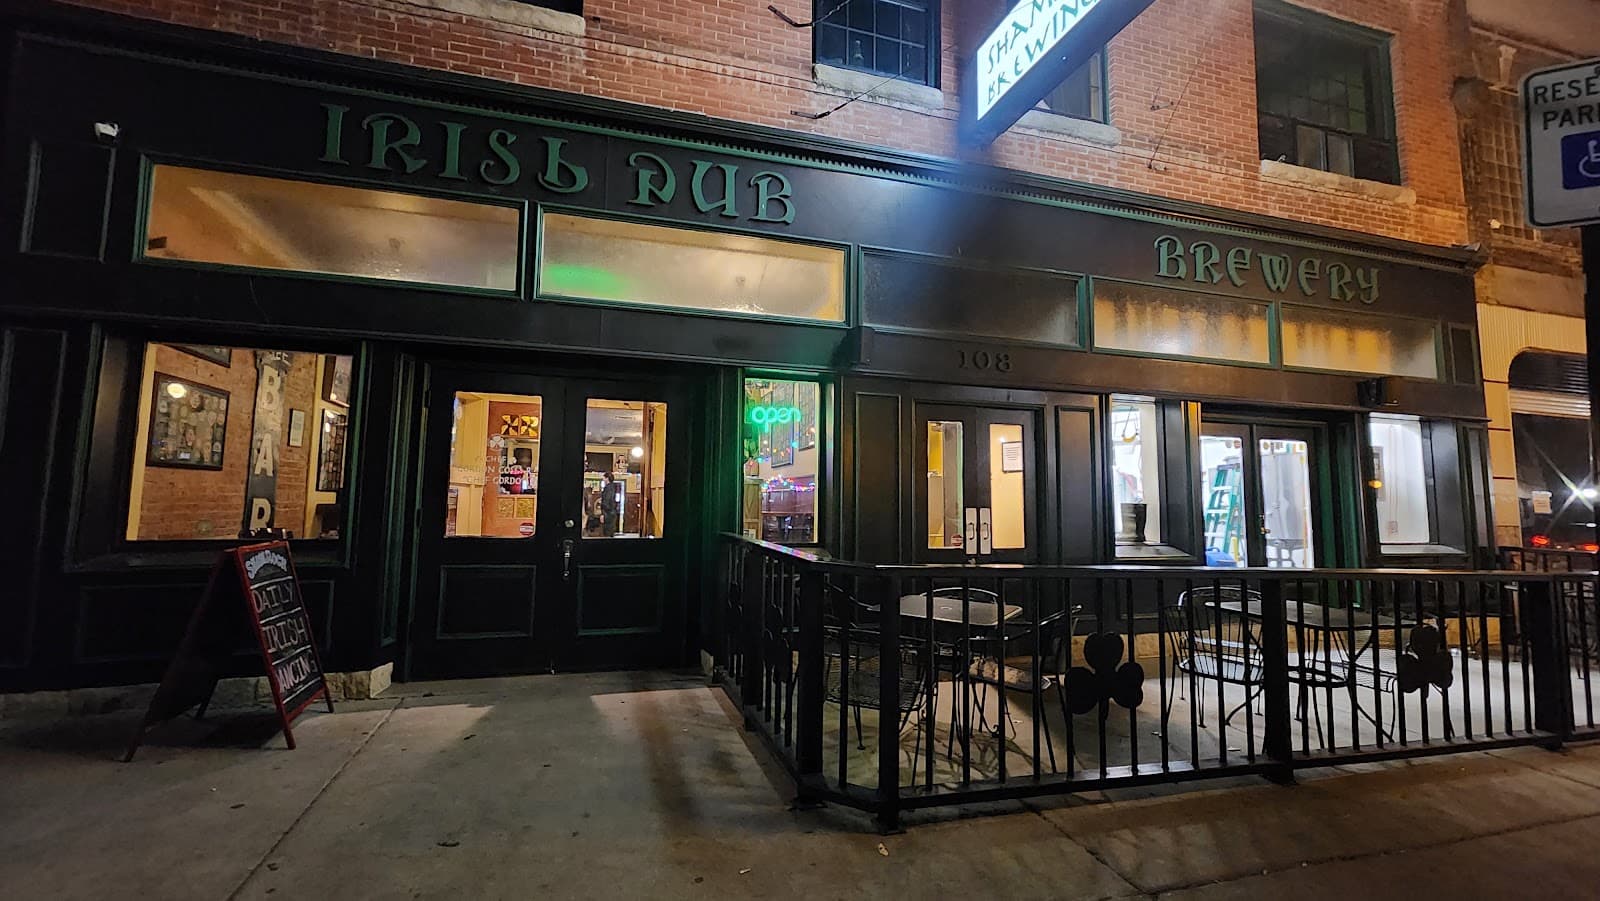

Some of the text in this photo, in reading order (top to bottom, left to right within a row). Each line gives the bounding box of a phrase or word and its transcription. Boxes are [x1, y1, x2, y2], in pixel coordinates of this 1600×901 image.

[1542, 102, 1600, 131] PAR
[626, 151, 796, 225] PUB
[1153, 234, 1382, 305] BREWERY
[955, 349, 1012, 374] 108
[751, 406, 802, 433] open
[251, 582, 294, 614] DAILY
[260, 617, 309, 653] IRISH
